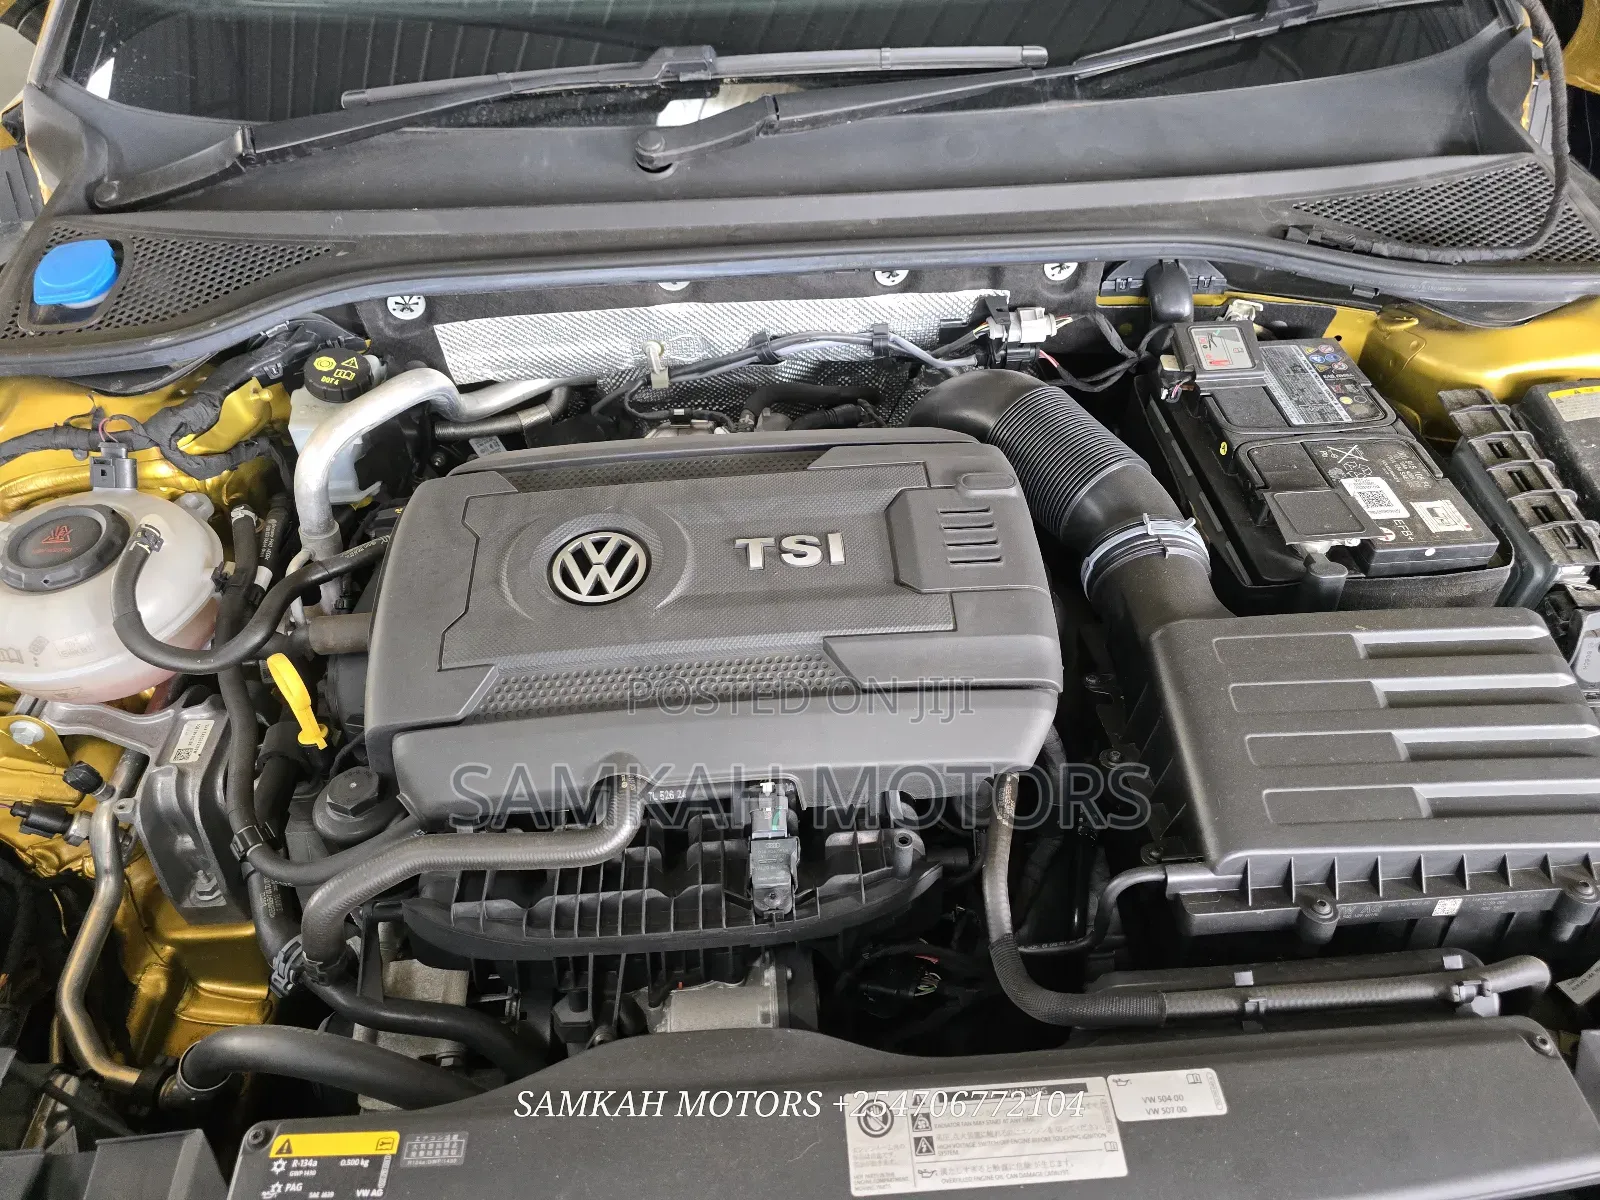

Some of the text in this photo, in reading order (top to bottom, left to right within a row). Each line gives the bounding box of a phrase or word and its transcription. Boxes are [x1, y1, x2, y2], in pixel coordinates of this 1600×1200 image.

[1393, 519, 1415, 542] EFB+
[735, 532, 846, 570] TSI
[659, 790, 674, 800] 526
[1142, 1096, 1156, 1104] VW
[1157, 1095, 1172, 1103] 504
[1145, 1107, 1159, 1115] VW
[292, 1158, 318, 1168] R-134a
[360, 1158, 370, 1168] kg
[285, 1183, 303, 1192] PAG
[356, 1189, 384, 1197] VW AG
